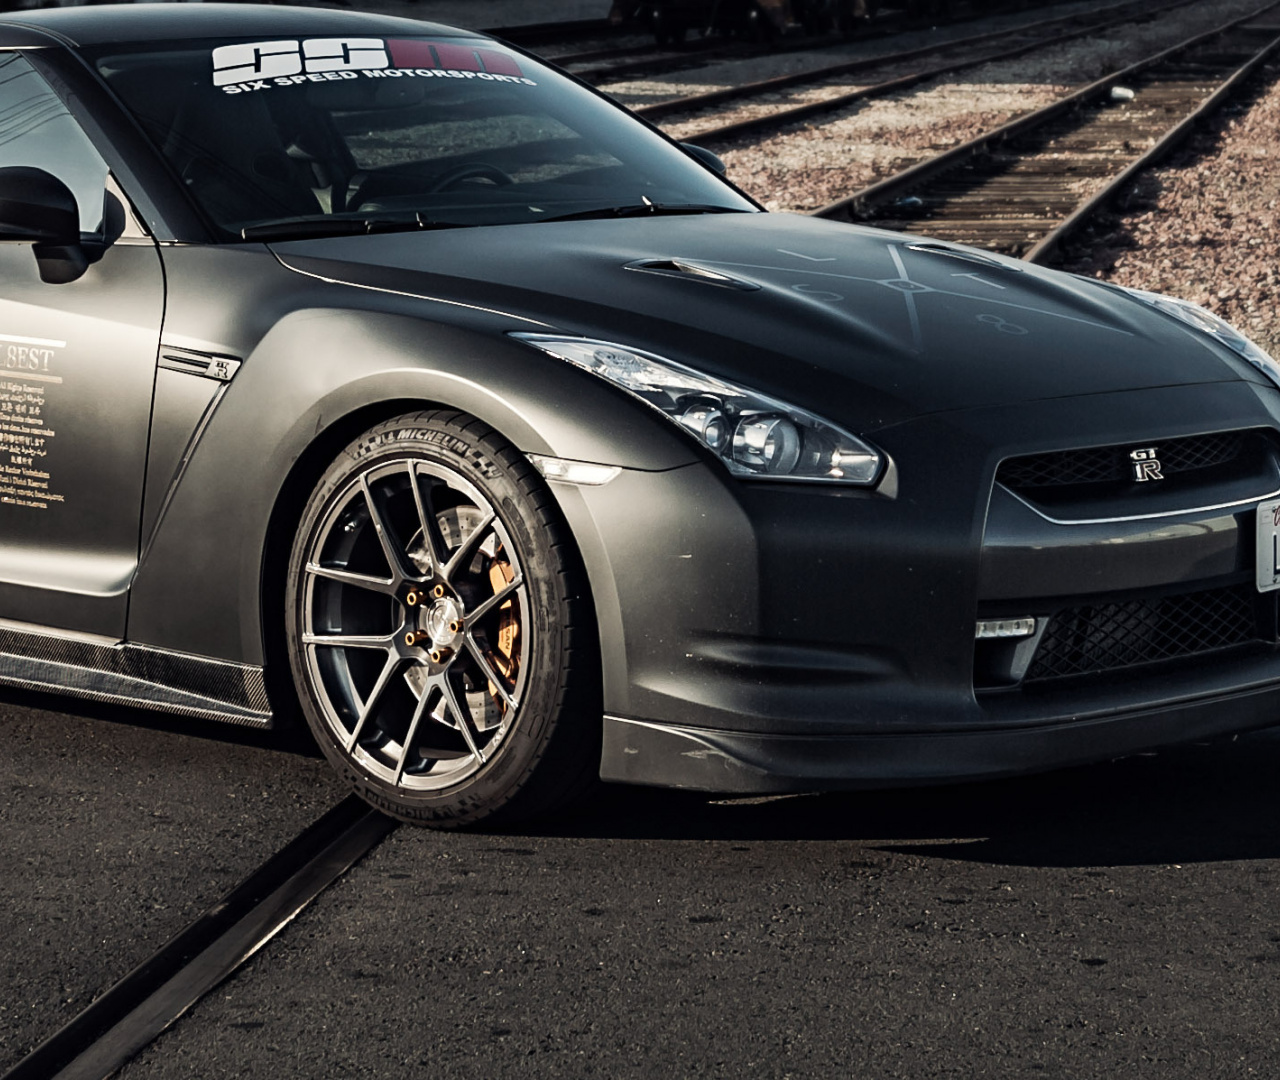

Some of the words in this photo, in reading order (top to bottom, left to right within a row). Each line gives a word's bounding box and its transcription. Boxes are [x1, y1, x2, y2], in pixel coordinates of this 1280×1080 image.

[222, 80, 271, 94] SIX
[273, 70, 358, 86] SPEED
[362, 68, 537, 87] MOTORSPORTS
[397, 428, 469, 457] MICHELIN
[1130, 447, 1158, 460] GT
[1132, 459, 1164, 482] R
